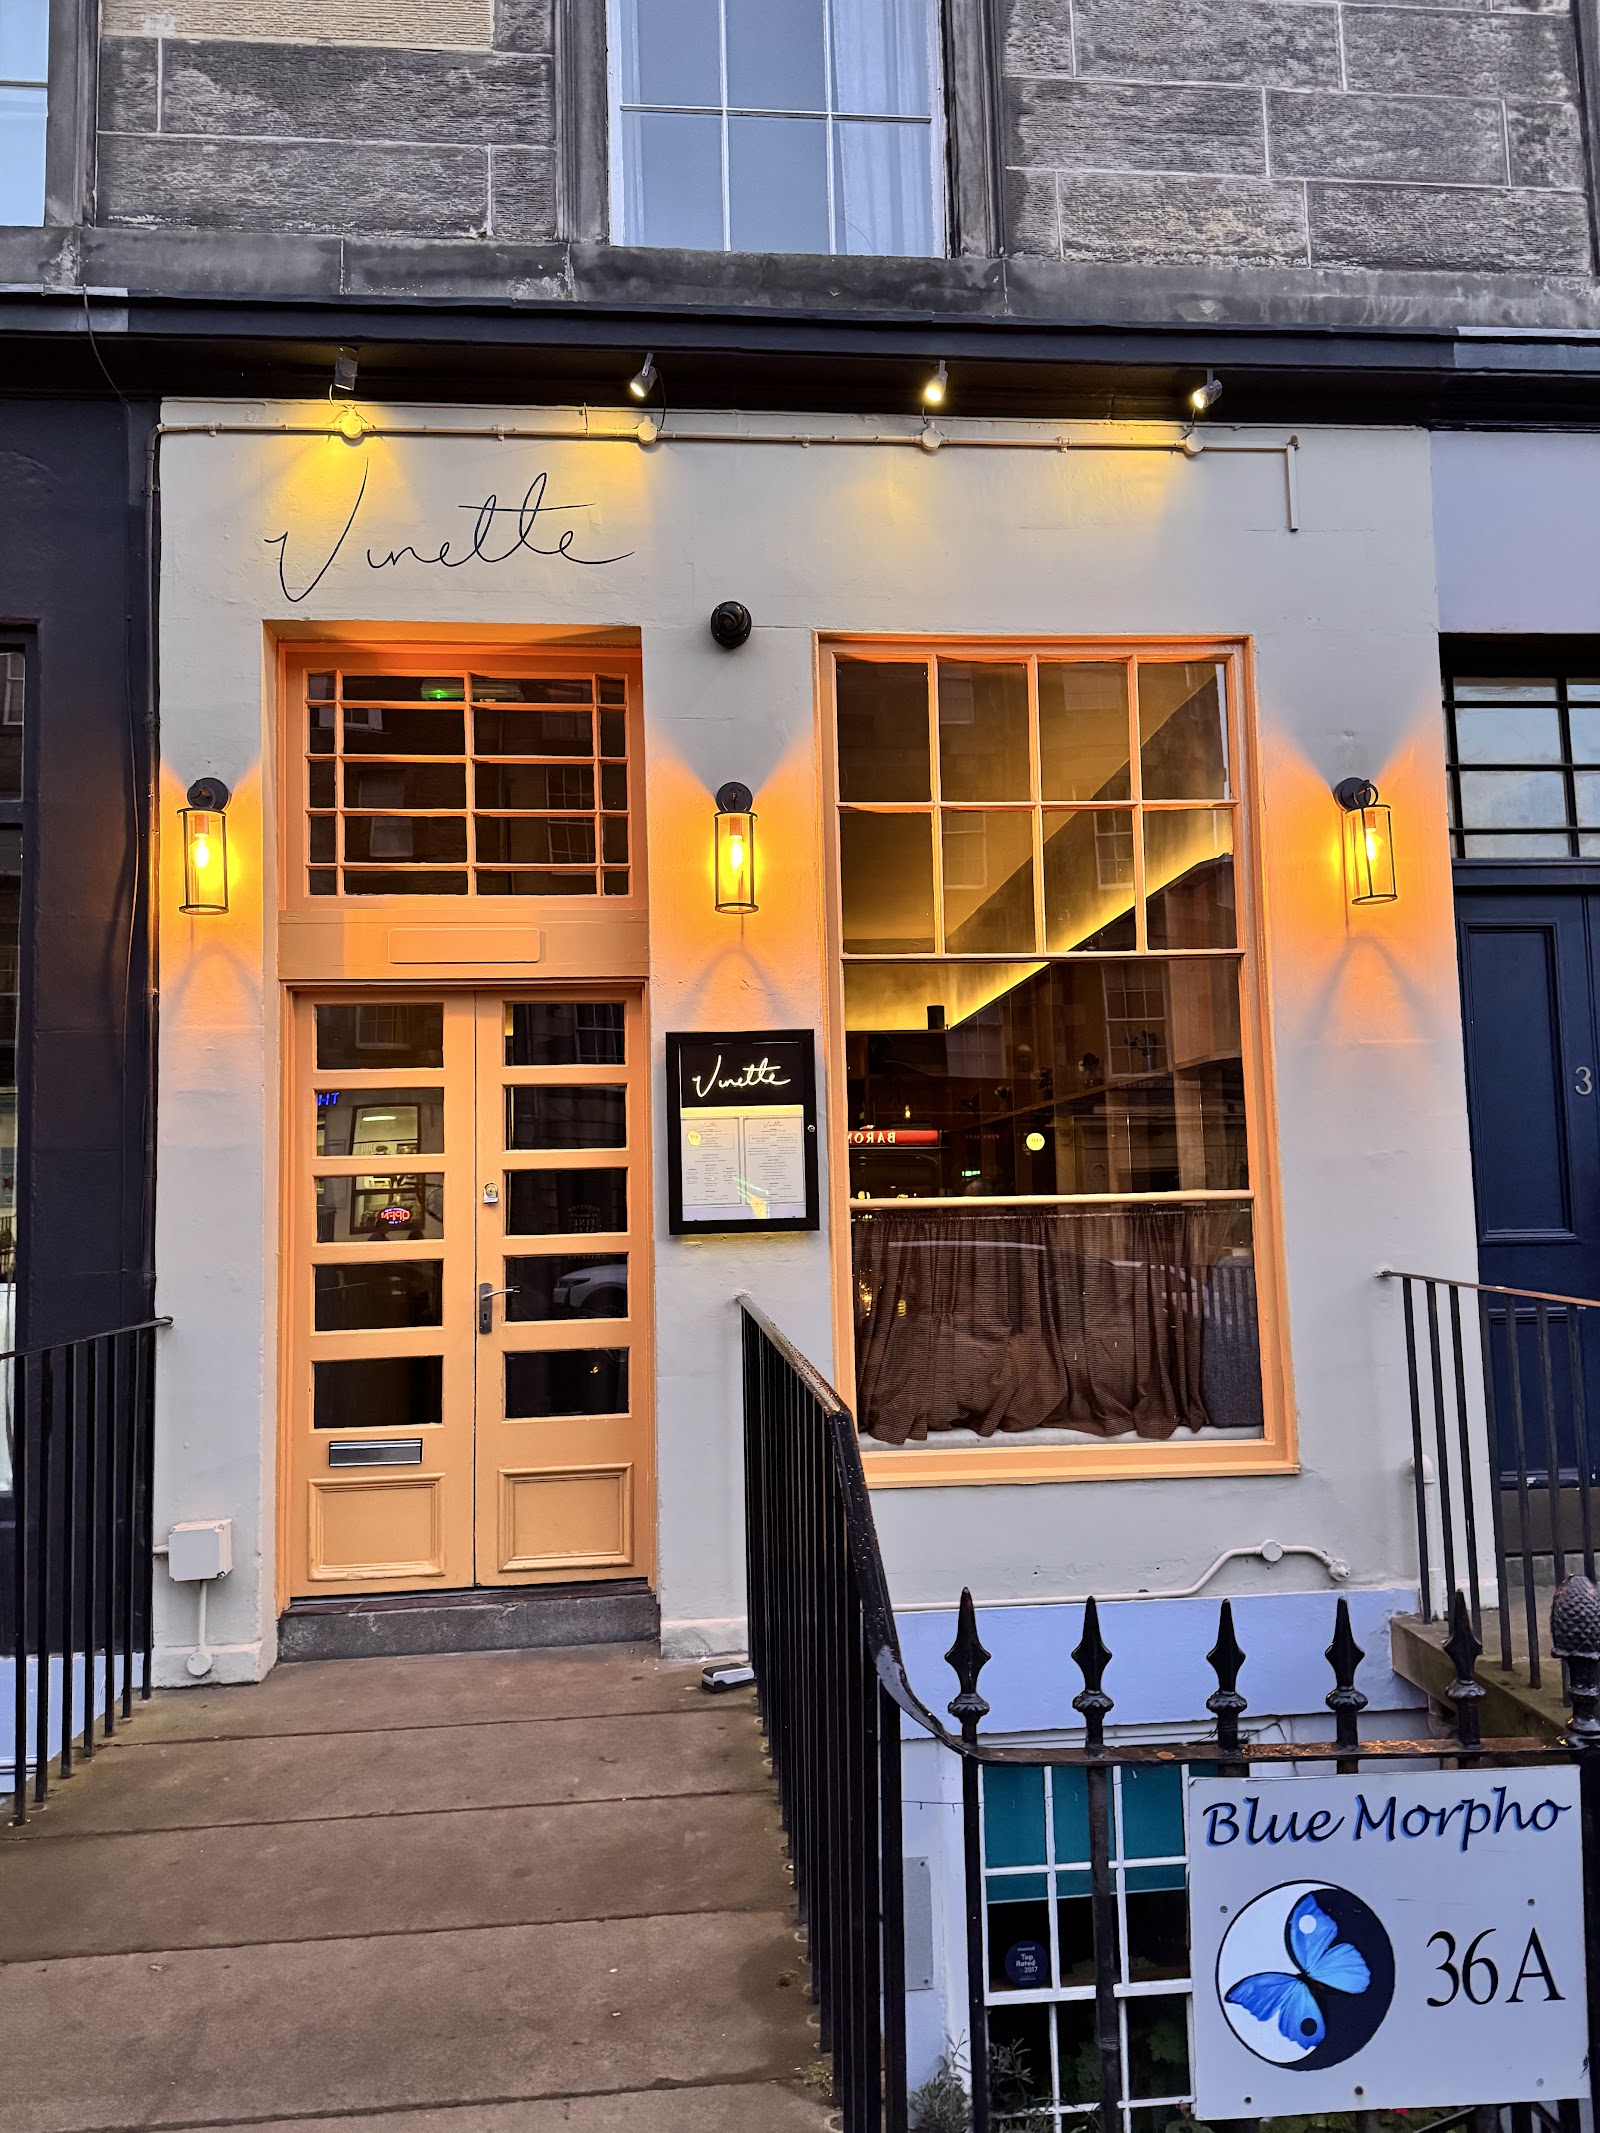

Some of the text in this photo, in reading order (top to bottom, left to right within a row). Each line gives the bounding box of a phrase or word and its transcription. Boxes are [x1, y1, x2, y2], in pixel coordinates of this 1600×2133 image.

[264, 457, 635, 603] Vinette
[691, 1054, 792, 1098] Vinette
[1575, 1066, 1592, 1095] 3
[1203, 1786, 1572, 1853] Blue Morpho
[1020, 1953, 1034, 1962] Top
[1426, 1927, 1566, 2008] 36A
